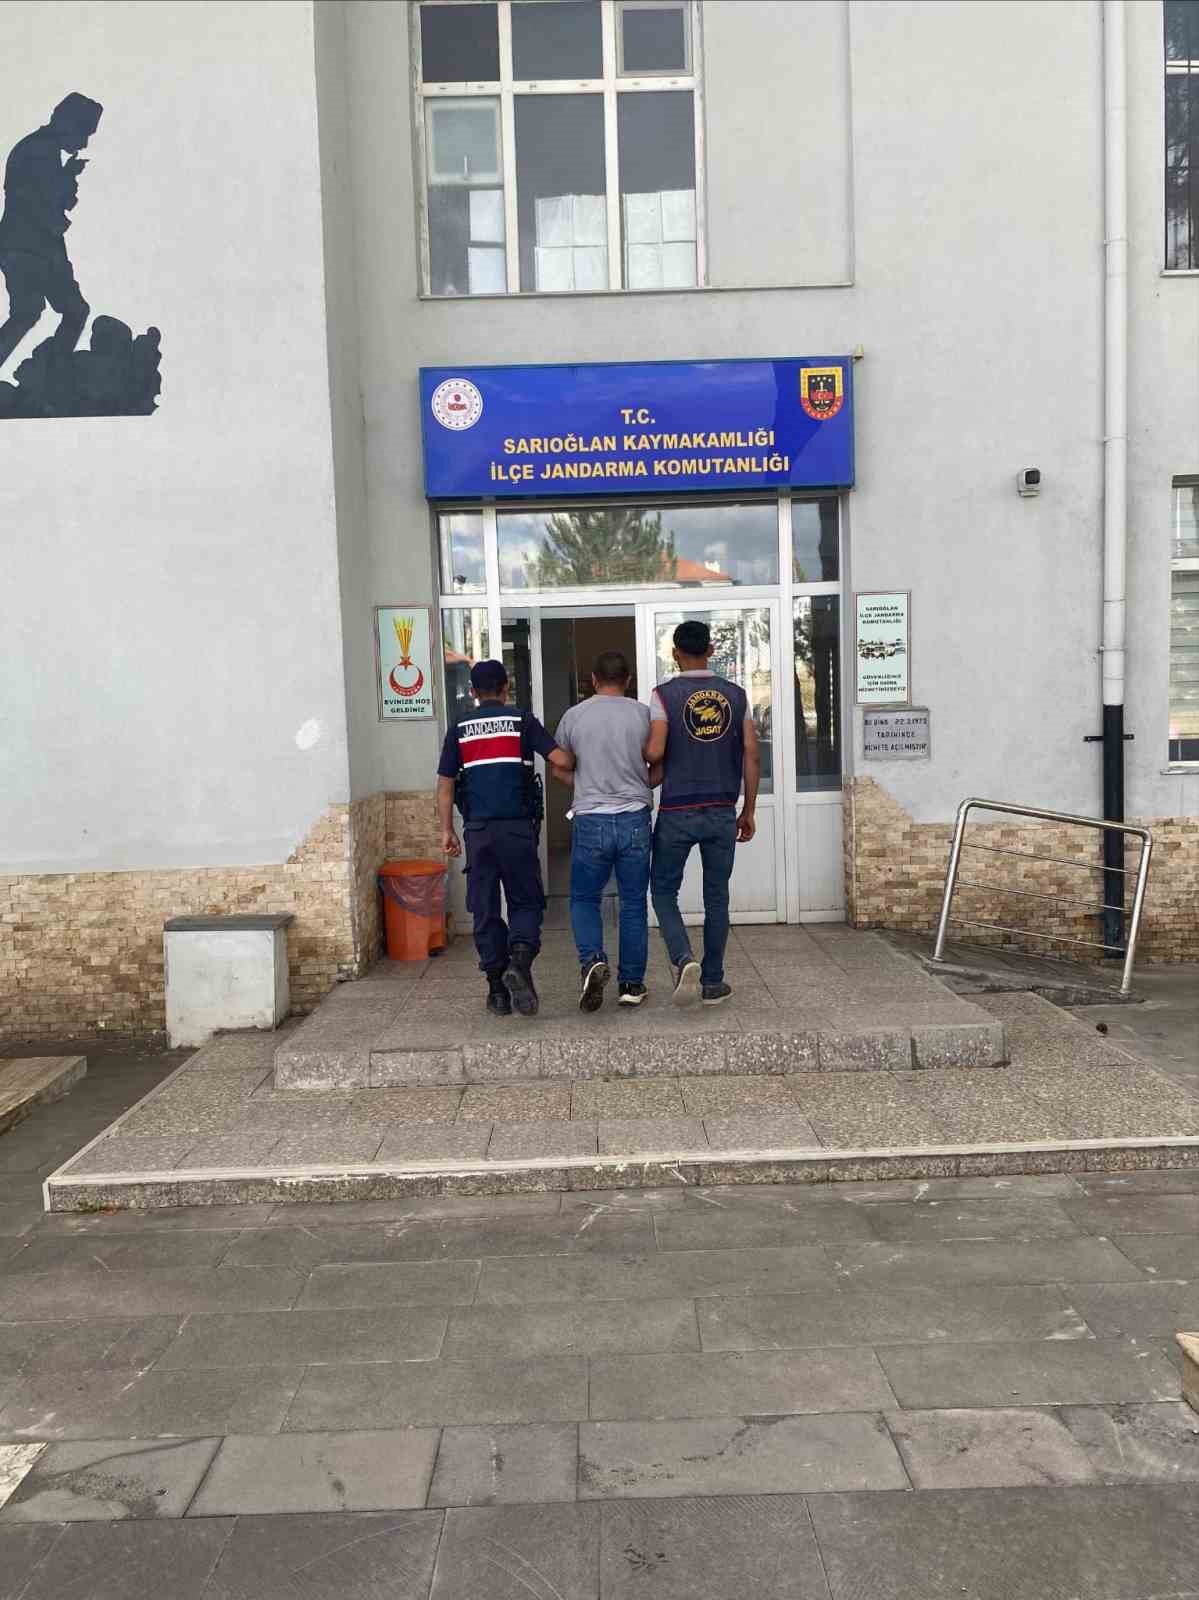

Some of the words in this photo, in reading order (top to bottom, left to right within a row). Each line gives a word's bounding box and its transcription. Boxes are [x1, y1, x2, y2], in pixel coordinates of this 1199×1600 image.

[621, 408, 656, 425] T.C.
[503, 432, 617, 454] SARIOĞLAN
[624, 427, 775, 451] KAYMAKAMLIĞI
[490, 461, 534, 485] İLÇE
[540, 460, 648, 480] JANDARMA
[654, 452, 789, 476] KOMUTANLIĞI
[463, 720, 515, 737] JANDARMA
[695, 725, 722, 736] JASAT
